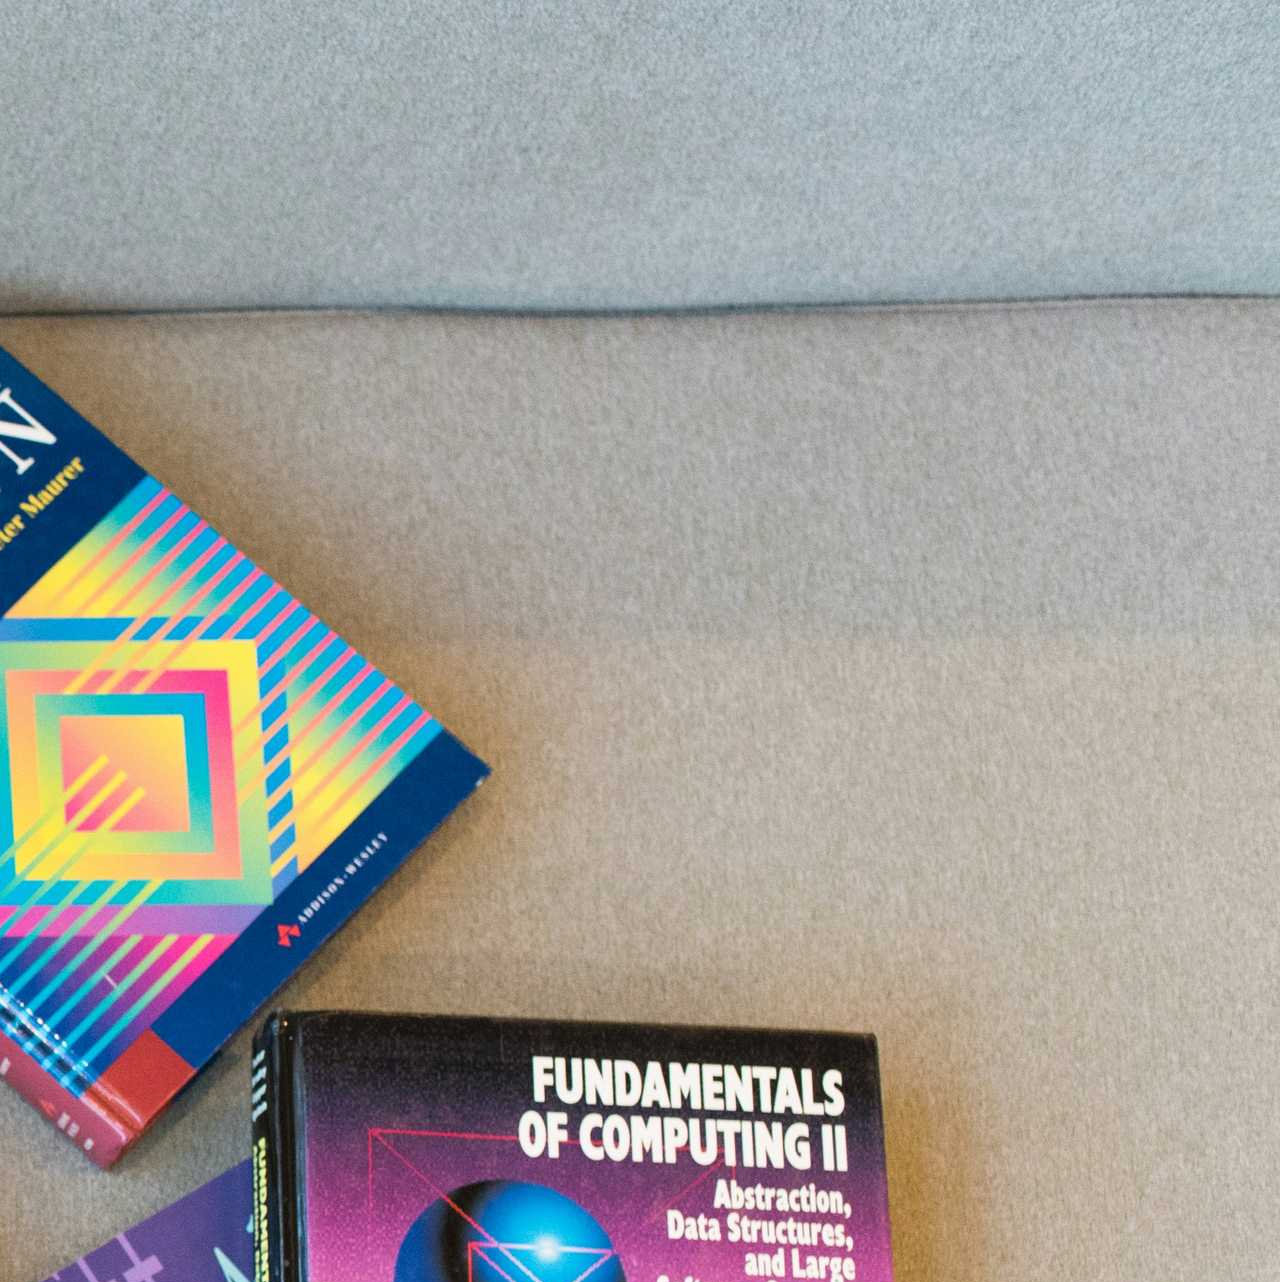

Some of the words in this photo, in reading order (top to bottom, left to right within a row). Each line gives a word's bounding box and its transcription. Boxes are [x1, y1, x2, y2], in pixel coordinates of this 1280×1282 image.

[19, 458, 82, 514] Maurer
[532, 1056, 845, 1116] FUNDAMENTALS
[518, 1110, 568, 1159] OF
[579, 1113, 812, 1170] COMPUTING
[821, 1124, 848, 1172] II
[713, 1179, 852, 1219] Abstraction,
[666, 1209, 722, 1241] Data
[726, 1212, 854, 1252] Structures,
[744, 1247, 786, 1278] and
